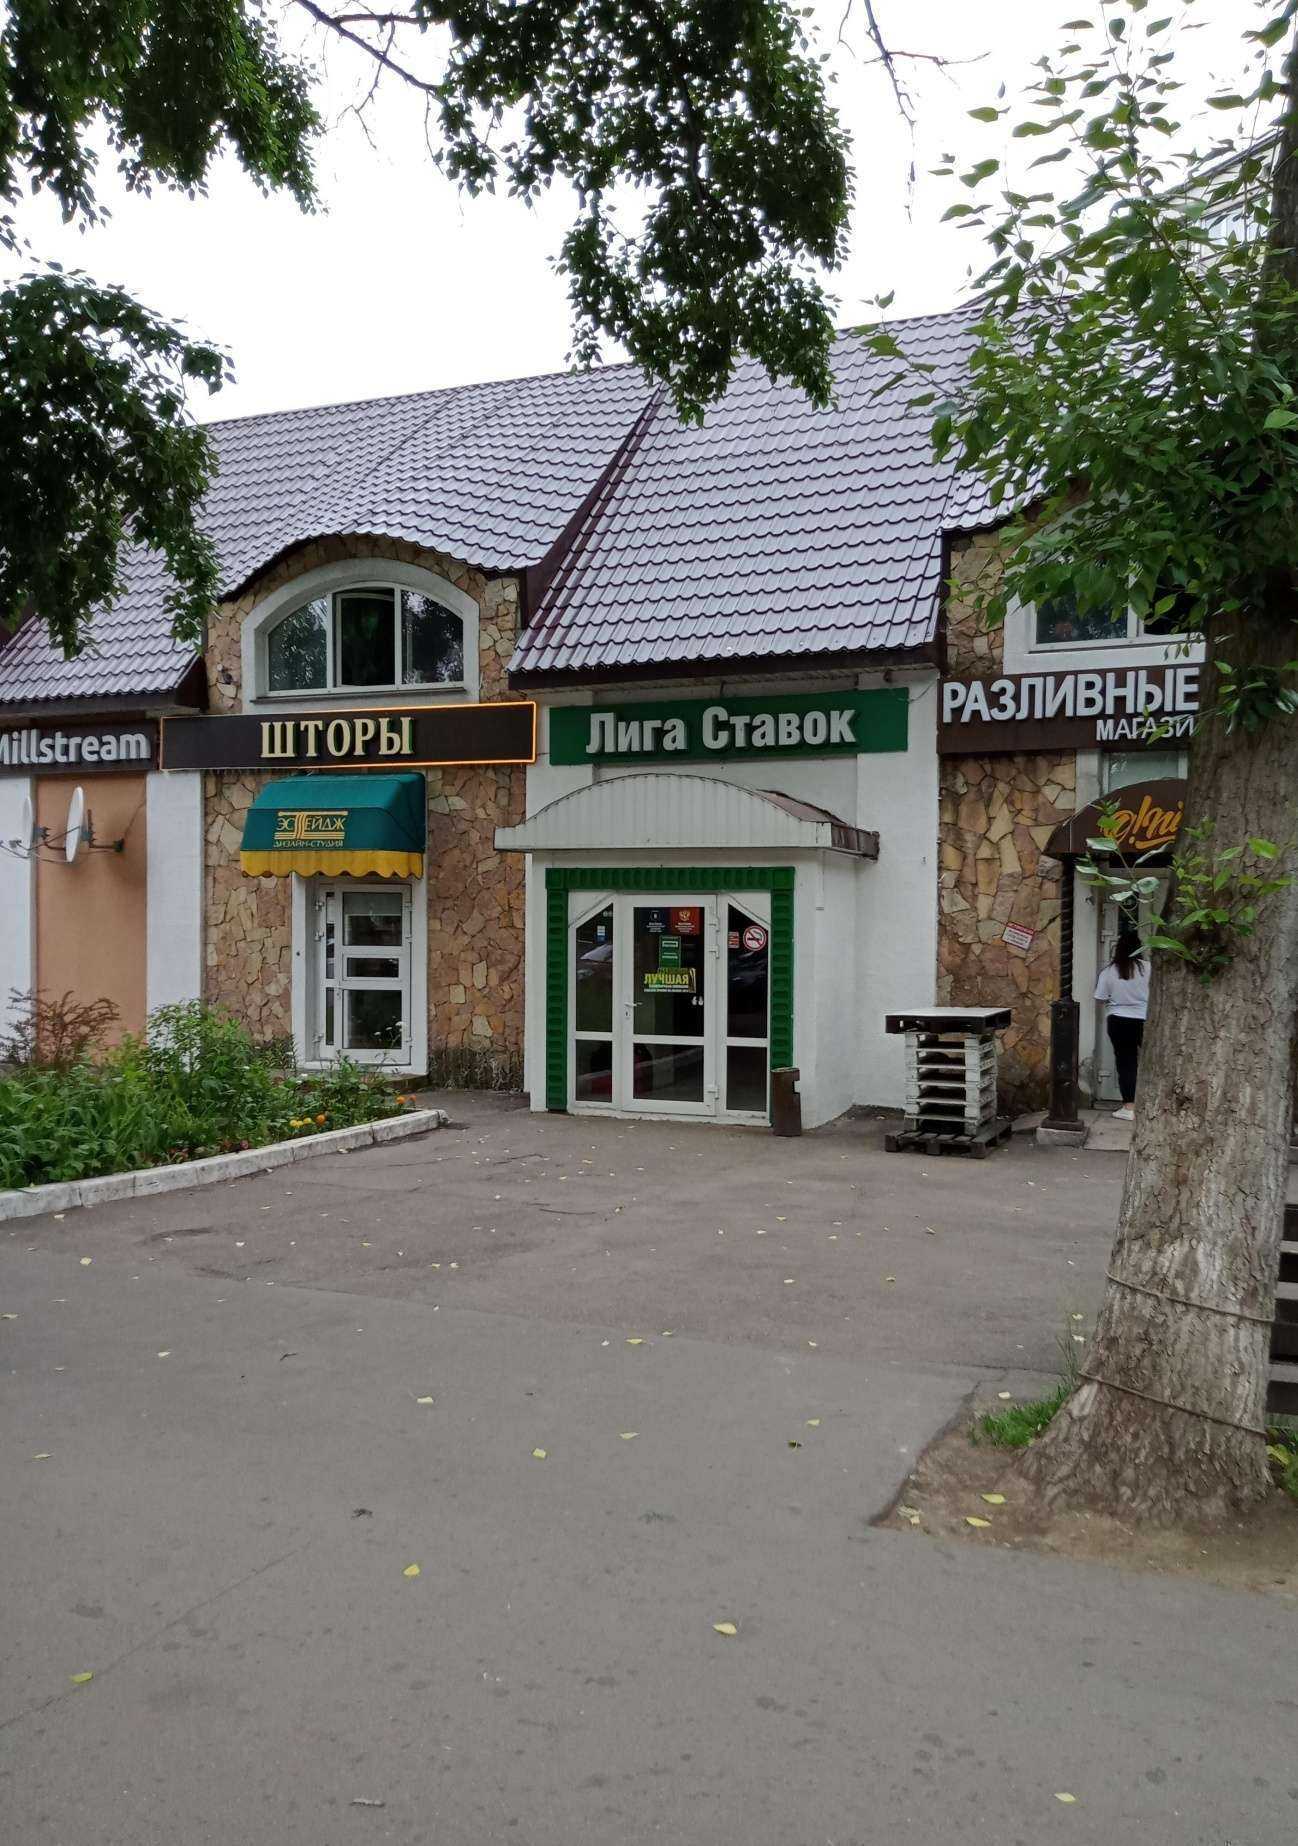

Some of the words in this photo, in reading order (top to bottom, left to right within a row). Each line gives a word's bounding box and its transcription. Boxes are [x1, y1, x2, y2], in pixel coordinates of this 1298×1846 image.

[943, 667, 1199, 723] РАЗЛИВНЫЕ
[260, 716, 414, 758] ШТОРЫ
[586, 712, 688, 754] Лига
[702, 706, 856, 750] Ставок
[1096, 714, 1195, 741] МАГАЗИ
[644, 973, 689, 985] ЛУЧШАЯ
